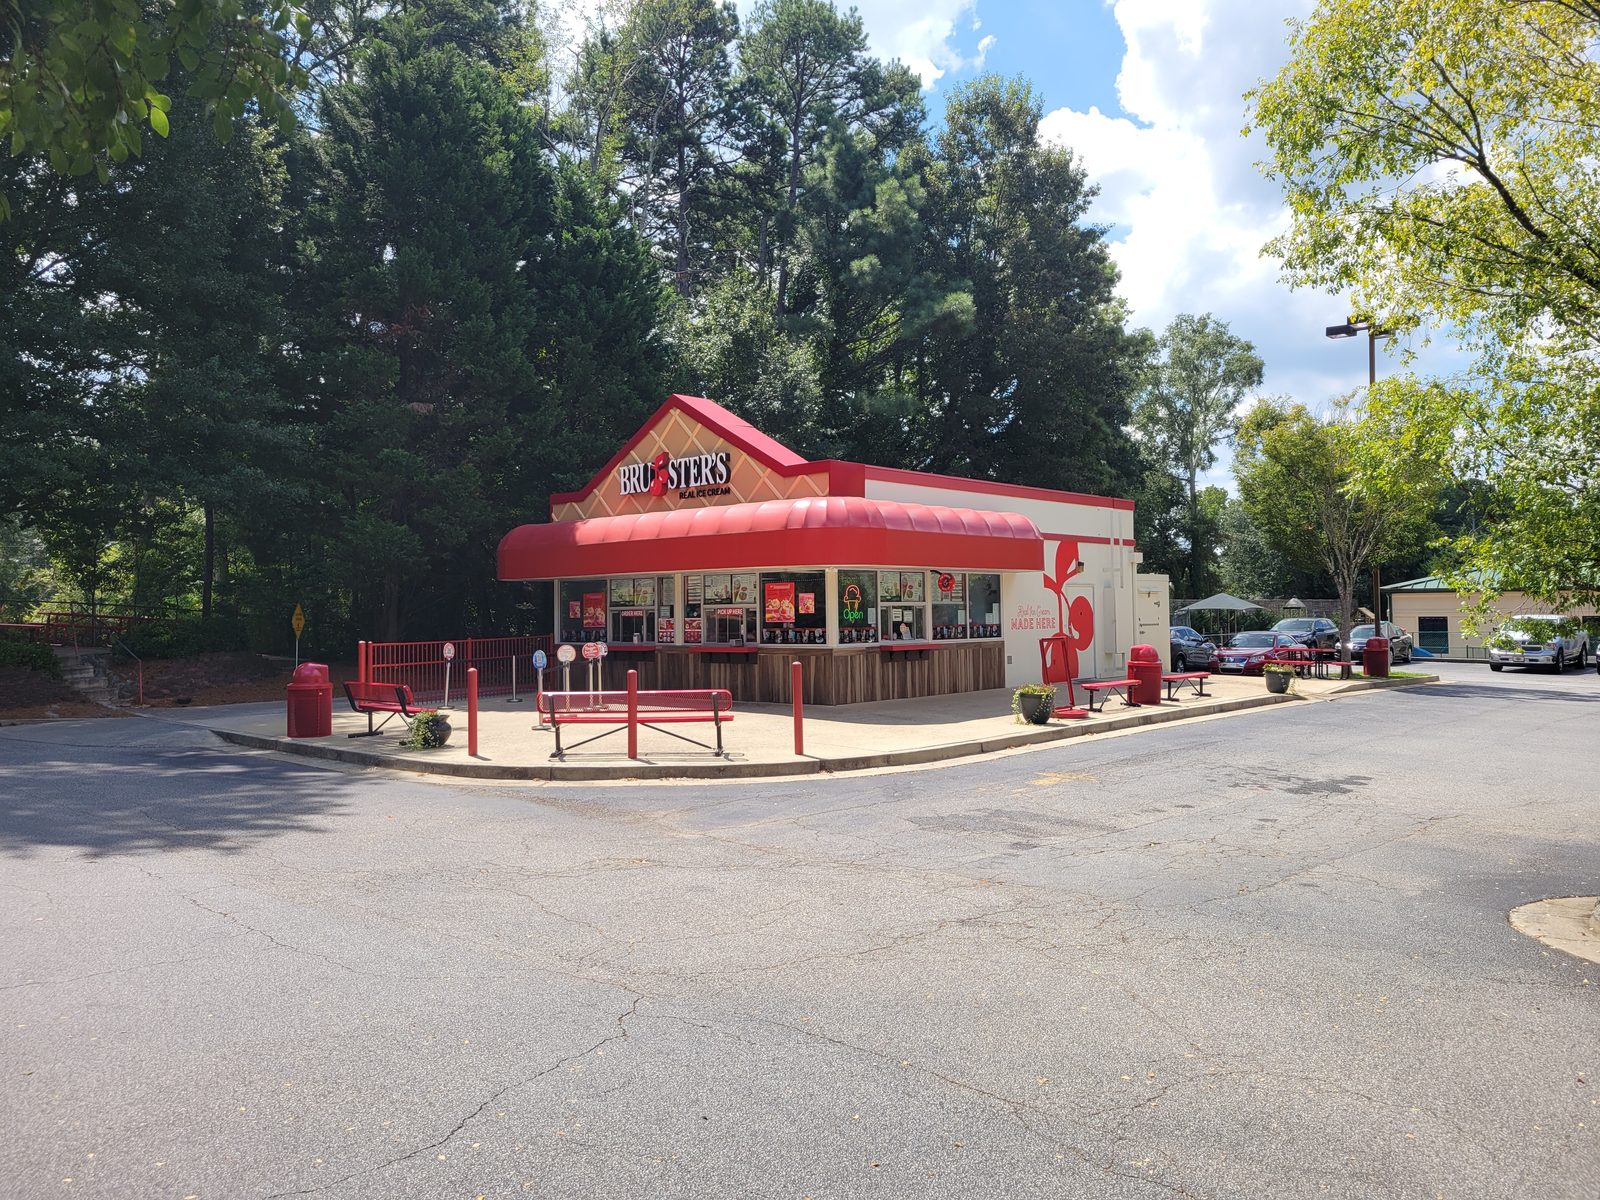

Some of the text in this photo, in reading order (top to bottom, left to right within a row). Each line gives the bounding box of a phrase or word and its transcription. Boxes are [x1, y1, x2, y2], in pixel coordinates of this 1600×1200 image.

[679, 486, 731, 500] REAL ICE CREAM
[843, 608, 864, 621] Open
[1011, 617, 1056, 630] MADE HERE
